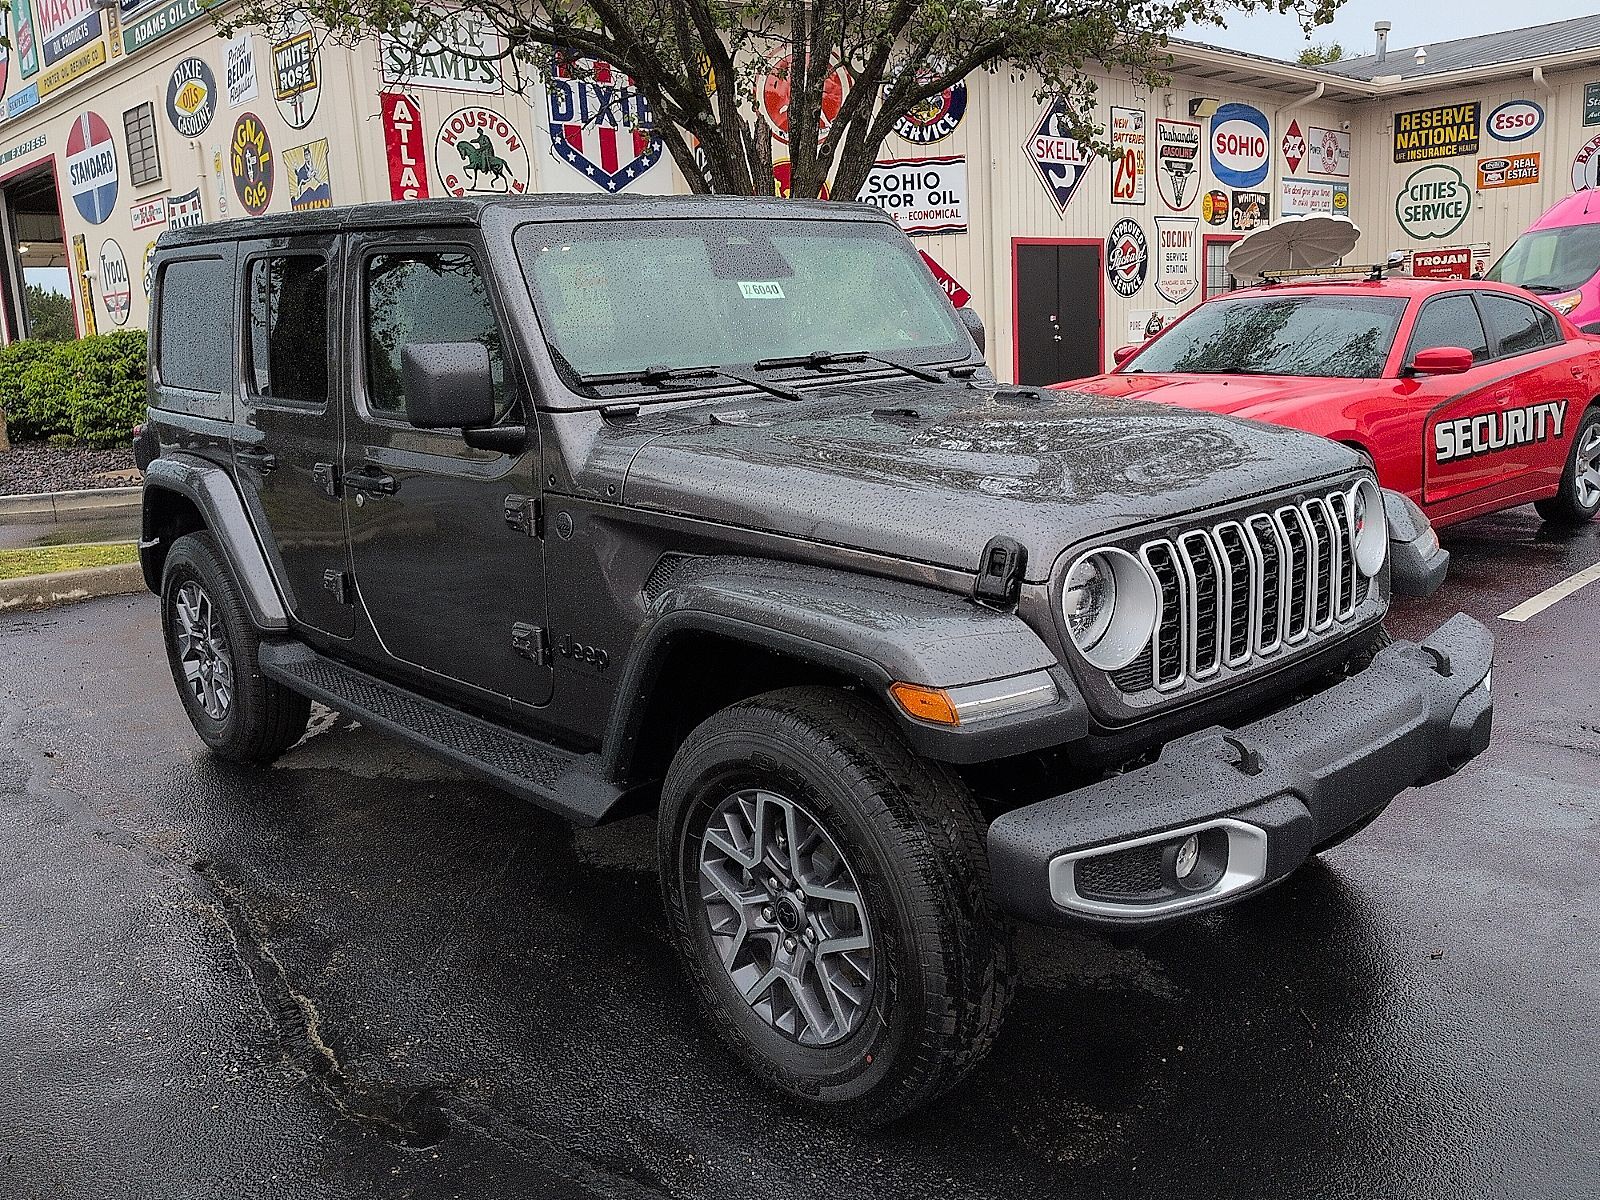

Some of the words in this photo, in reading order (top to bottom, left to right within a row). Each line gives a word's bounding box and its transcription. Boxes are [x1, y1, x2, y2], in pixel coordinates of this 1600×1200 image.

[134, 13, 167, 45] ADAMS
[169, 3, 186, 24] OIL
[53, 39, 63, 55] OIL
[62, 22, 90, 51] PRODUCTS
[227, 36, 247, 65] Priced
[275, 40, 310, 71] WHITE
[388, 42, 496, 84] STAMPS
[43, 71, 60, 90] PORTER
[61, 67, 69, 78] OIL
[70, 54, 90, 74] REFINING
[173, 58, 204, 89] DIXIE
[227, 52, 252, 89] BELOW
[279, 65, 311, 91] ROSE
[182, 87, 199, 110] OILS
[550, 79, 654, 129] DIXIE
[177, 102, 213, 136] GASOLINE
[441, 110, 521, 152] HOUSTON
[892, 112, 959, 141] SERVICE
[1113, 117, 1129, 129] NEW
[1400, 105, 1475, 132] RESERVE
[1113, 133, 1145, 145] BATTERIES
[1158, 123, 1199, 144] Panhandle
[1216, 132, 1265, 158] SOHIO
[1396, 124, 1479, 150] NATIONAL
[11, 135, 46, 159] EXPRESS
[232, 118, 270, 178] SIGNAL
[1036, 139, 1086, 162] SKELL
[1162, 147, 1194, 159] GASOLINE
[1407, 145, 1458, 160] INSURANCE
[1458, 143, 1478, 154] HEALTH
[70, 150, 114, 186] STANDARD
[1113, 148, 1136, 199] 29
[1507, 167, 1539, 181] ESTATE
[1513, 158, 1536, 169] REAL
[244, 181, 268, 208] GAS
[868, 171, 941, 195] SOHIO
[1410, 180, 1457, 202] CITIES
[857, 193, 914, 209] OTOR
[927, 190, 960, 206] OIL
[1237, 193, 1266, 206] WHITING
[1404, 201, 1463, 223] SERVICE
[1112, 221, 1144, 246] APPROVED
[1161, 230, 1193, 249] SOCONY
[1109, 243, 1147, 271] Packard
[1165, 252, 1188, 263] SERVICE
[1165, 264, 1188, 274] STATION
[1415, 254, 1468, 267] TROJAN
[752, 284, 780, 296] 6040
[1112, 273, 1143, 295] SERVICE
[1434, 399, 1568, 463] SECURITY
[558, 633, 610, 671] Jeep
